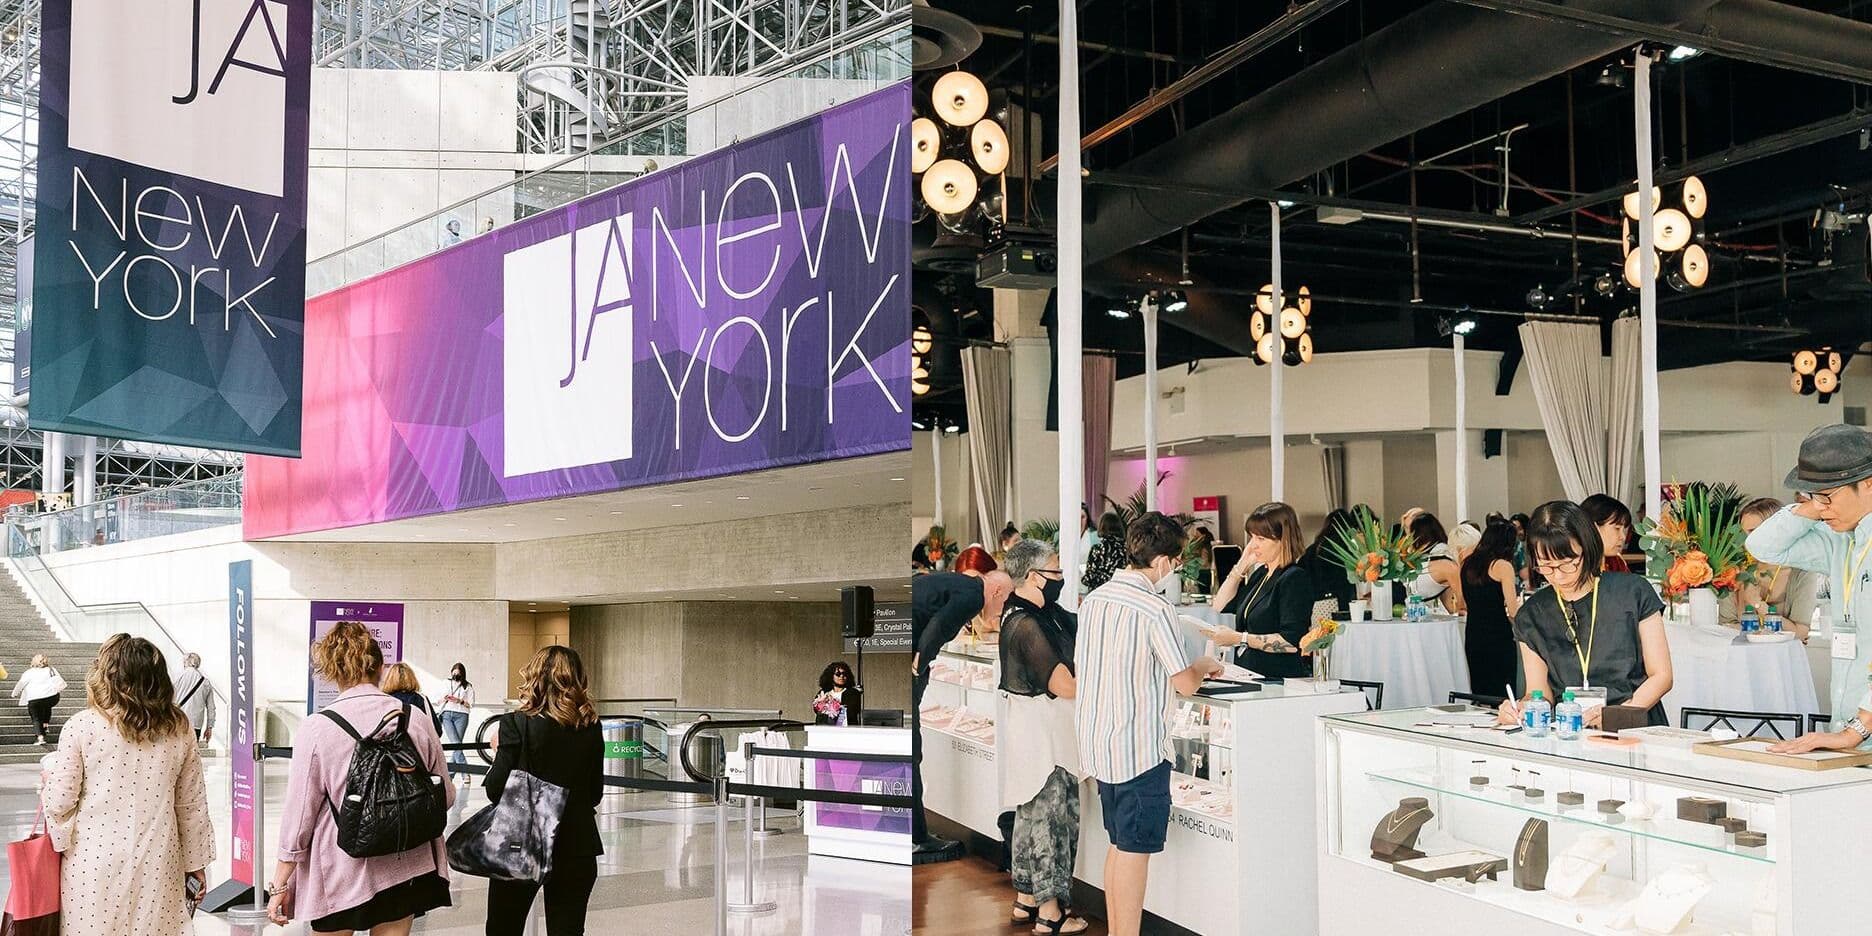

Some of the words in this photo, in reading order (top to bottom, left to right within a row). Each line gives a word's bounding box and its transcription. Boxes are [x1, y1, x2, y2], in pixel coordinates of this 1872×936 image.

[172, 0, 287, 104] JA
[559, 216, 633, 388] JA
[236, 587, 246, 700] FOLLOW
[880, 638, 898, 646] Special
[884, 623, 902, 632] Crystal
[237, 708, 247, 745] US
[1178, 814, 1208, 835] RACHEL
[1208, 823, 1234, 842] QUINN
